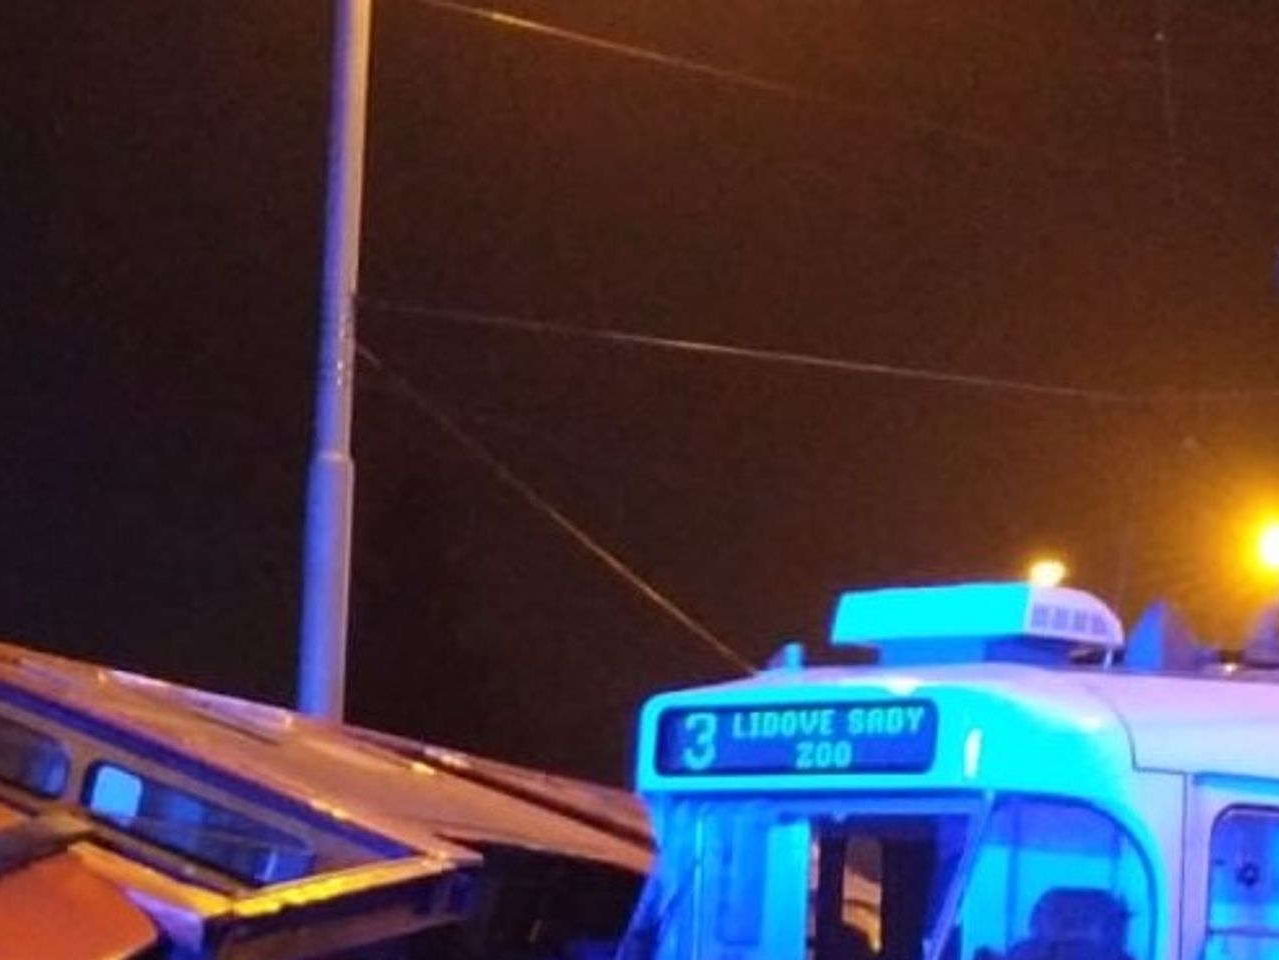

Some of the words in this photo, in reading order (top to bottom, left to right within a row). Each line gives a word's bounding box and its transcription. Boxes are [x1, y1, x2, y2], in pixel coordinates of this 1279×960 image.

[731, 708, 837, 738] LIDOVE
[847, 706, 925, 735] SADY
[682, 711, 717, 770] 3
[794, 741, 853, 770] ZOO
